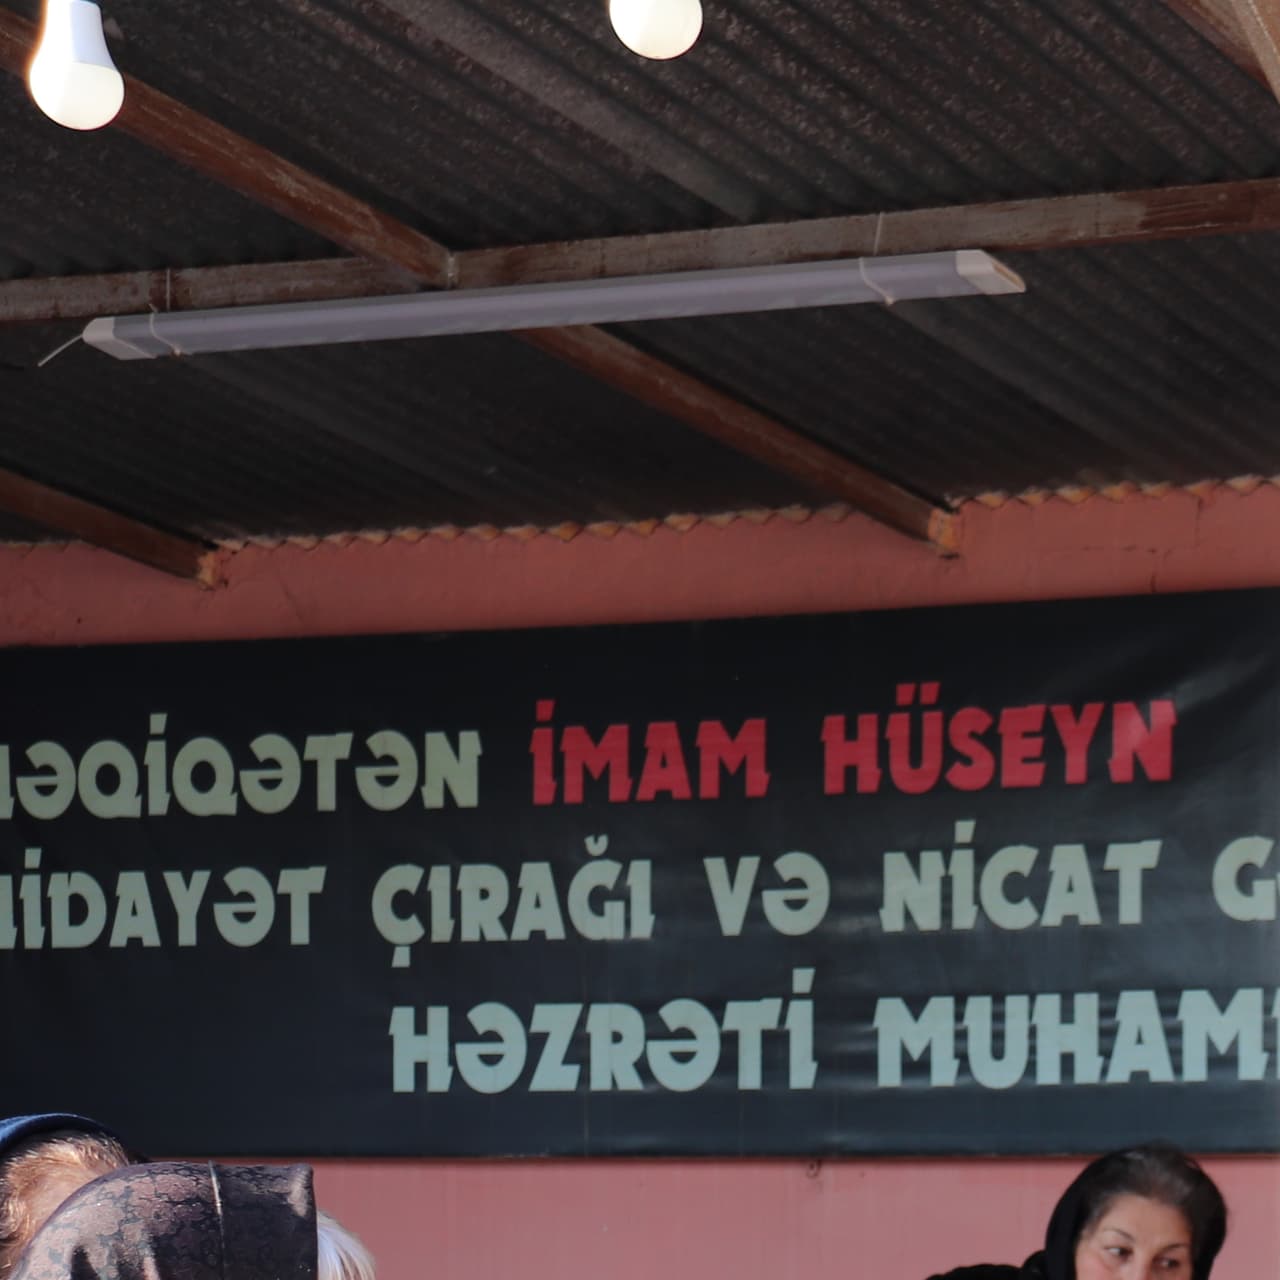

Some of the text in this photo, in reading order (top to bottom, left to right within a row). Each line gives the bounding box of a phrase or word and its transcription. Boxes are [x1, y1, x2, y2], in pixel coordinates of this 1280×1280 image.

[529, 699, 771, 805] İMAM
[820, 681, 1178, 795] HÜSEYN
[371, 835, 655, 968] ÇIRAĞI
[703, 852, 831, 936] VƏ
[880, 820, 1163, 933] NİCAT
[388, 968, 819, 1094] HƏZRƏTİ
